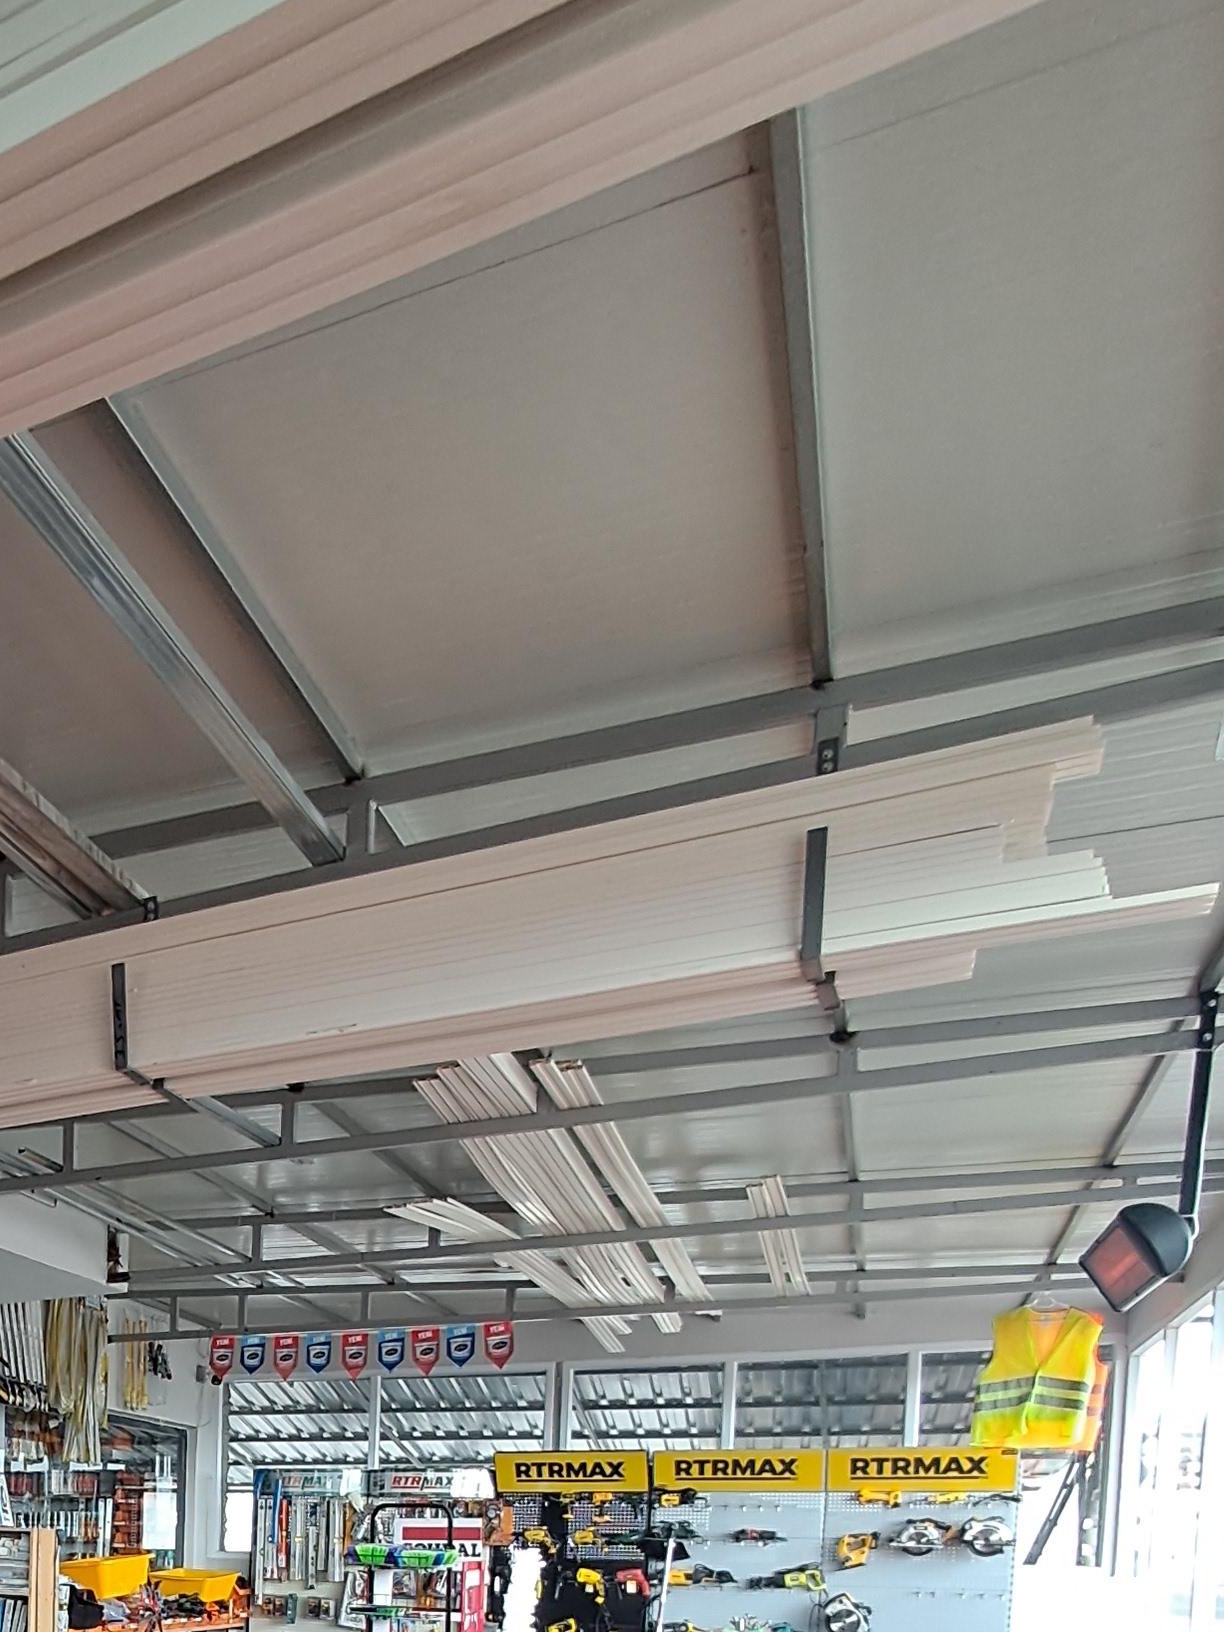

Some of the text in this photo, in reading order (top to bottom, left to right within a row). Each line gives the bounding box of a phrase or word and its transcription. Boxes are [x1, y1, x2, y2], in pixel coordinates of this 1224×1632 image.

[515, 1461, 625, 1478] RTRMAX
[674, 1458, 798, 1476] RTRMAX
[849, 1456, 989, 1475] RTRMAX
